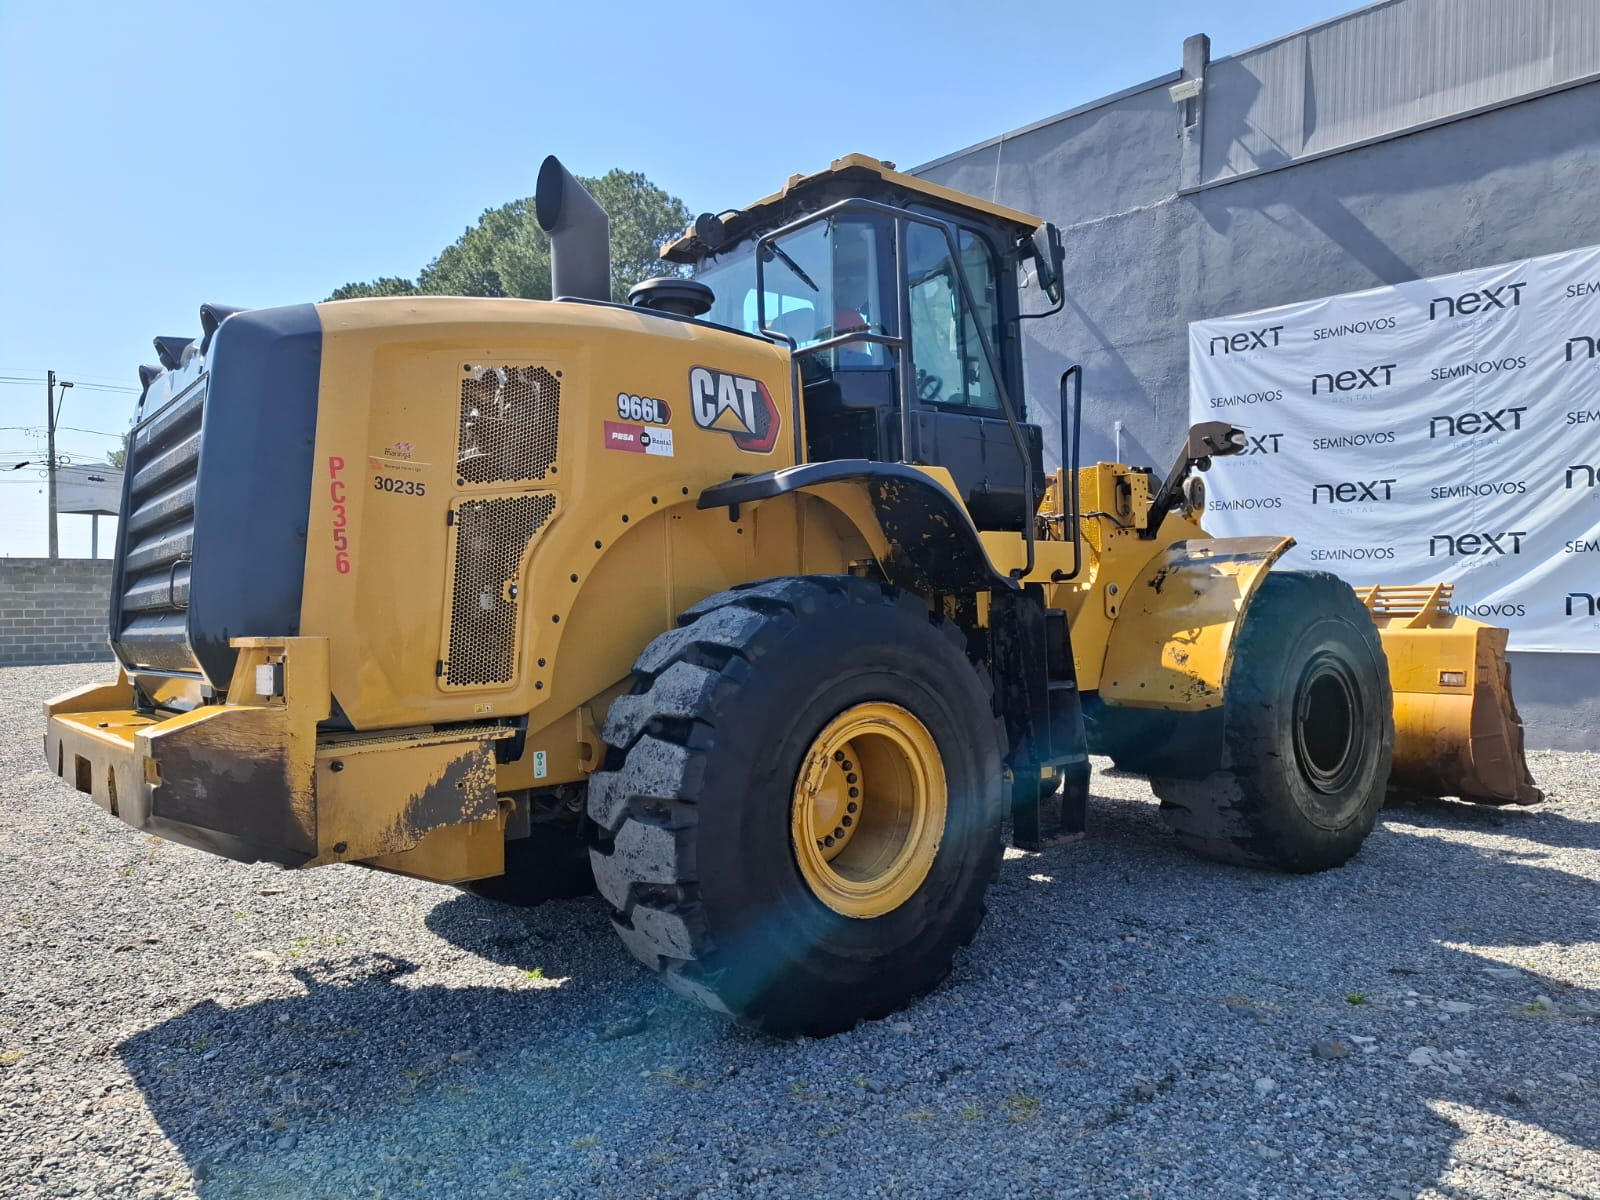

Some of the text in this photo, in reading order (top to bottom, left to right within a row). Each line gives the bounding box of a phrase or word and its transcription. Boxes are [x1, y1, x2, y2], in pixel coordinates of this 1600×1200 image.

[1313, 317, 1396, 341] SEMINOVOS
[1431, 356, 1527, 380] SEMINOVOS
[618, 393, 663, 423] 966L
[690, 368, 757, 434] CAT
[1210, 390, 1283, 408] SEMINOVOS
[651, 436, 672, 446] Rental
[1313, 432, 1395, 450] SEMINOVOS
[374, 475, 425, 496] 30235
[1431, 481, 1526, 499] SEMINOVOS
[1208, 497, 1282, 511] SEMINOVOS
[328, 456, 351, 574] PC356
[1310, 548, 1394, 560] SEMINOVOS
[1438, 604, 1525, 616] MINOVOS
